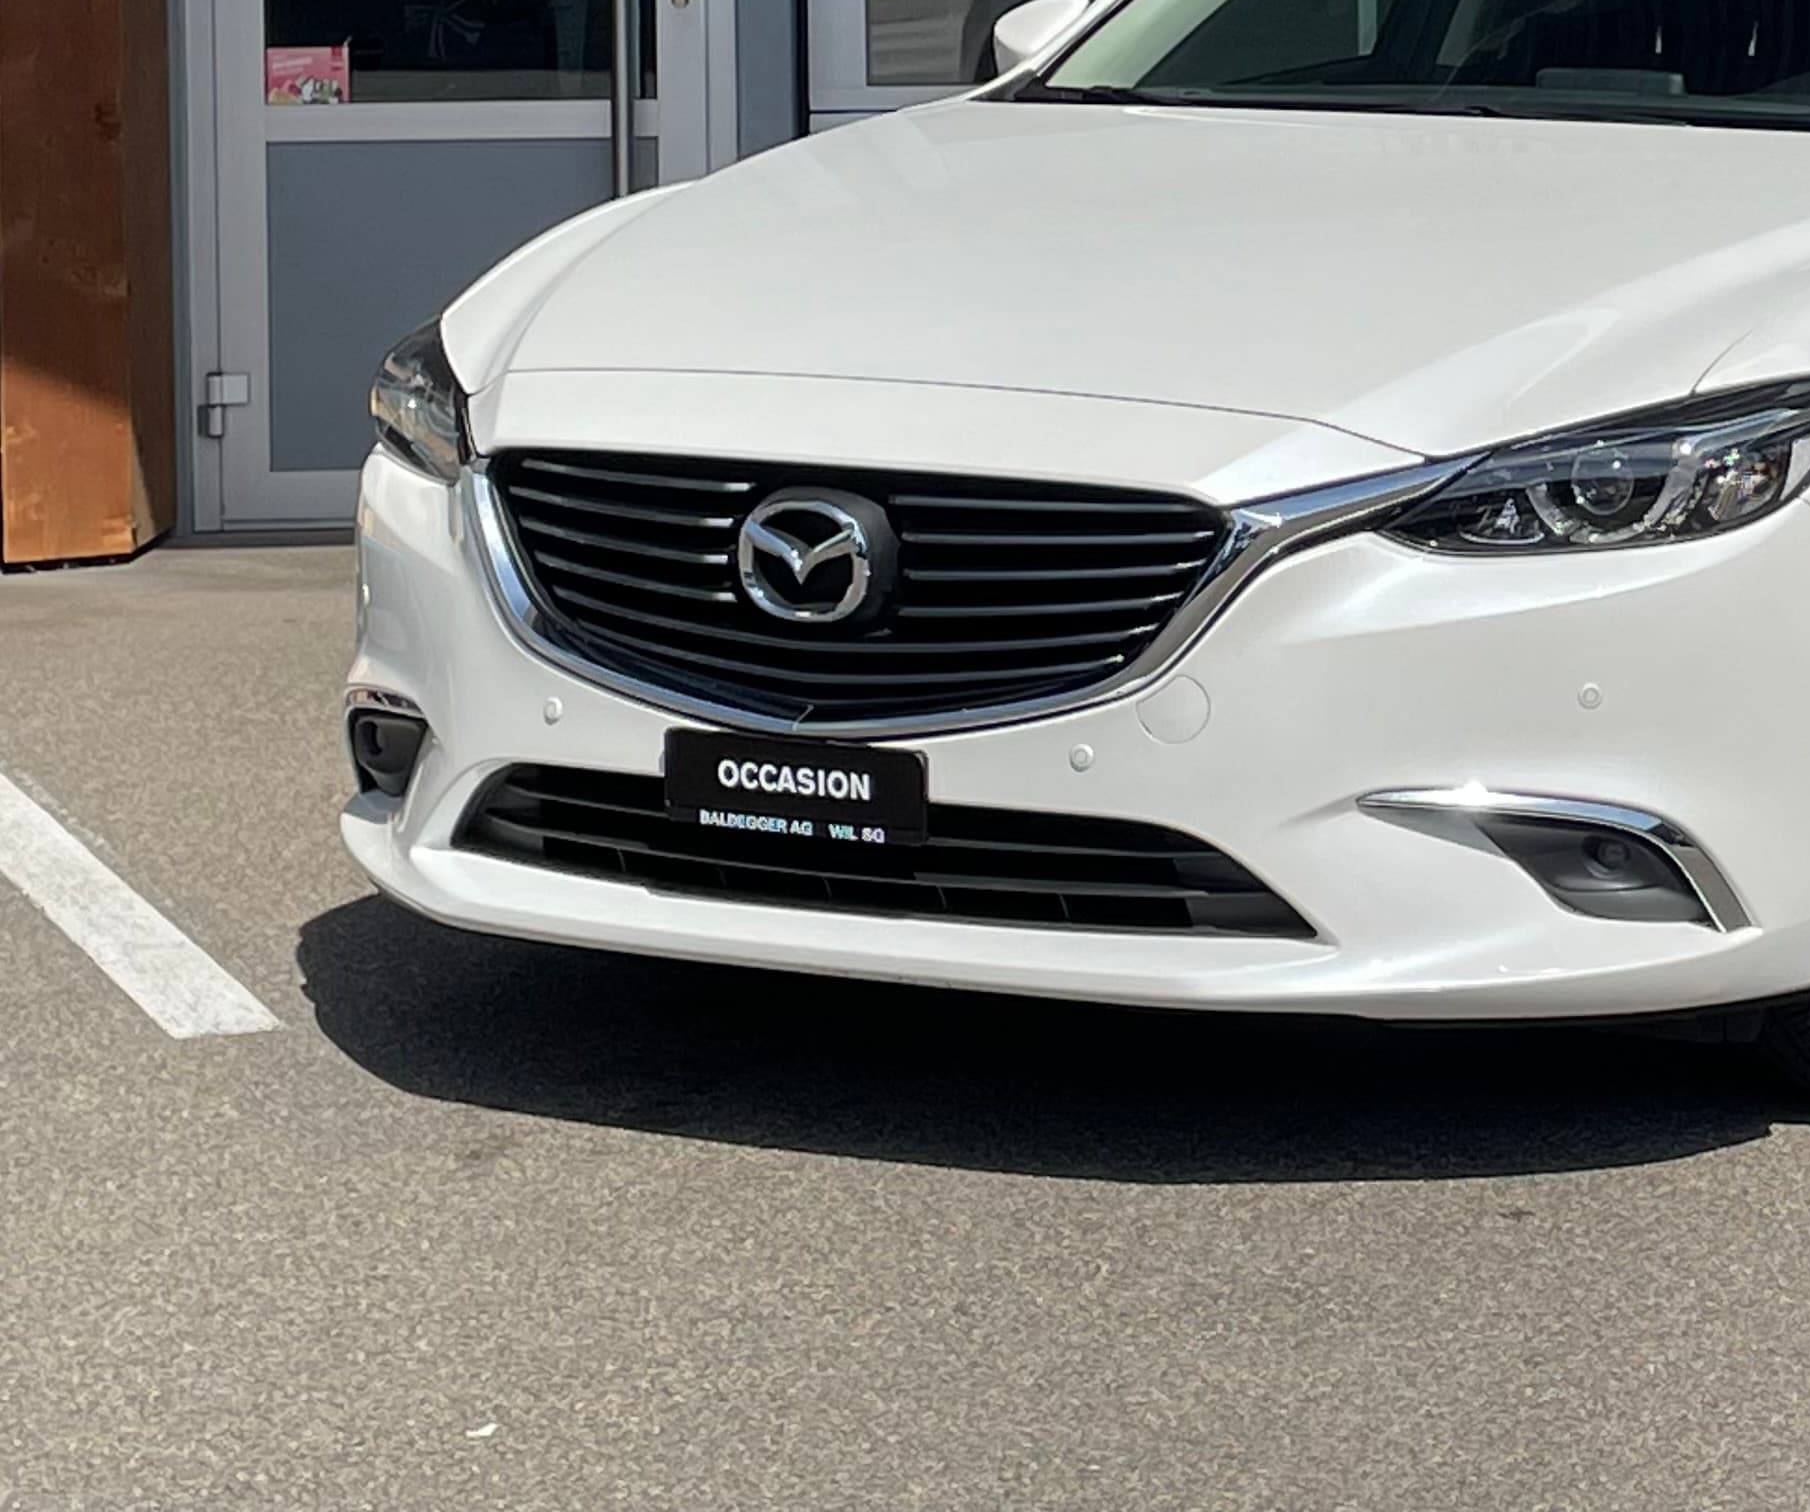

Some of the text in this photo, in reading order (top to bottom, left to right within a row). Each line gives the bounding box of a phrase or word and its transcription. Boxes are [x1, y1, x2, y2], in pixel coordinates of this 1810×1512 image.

[717, 759, 871, 801] OCCASION
[699, 808, 885, 844] BALDEGGER AG WIL SG
